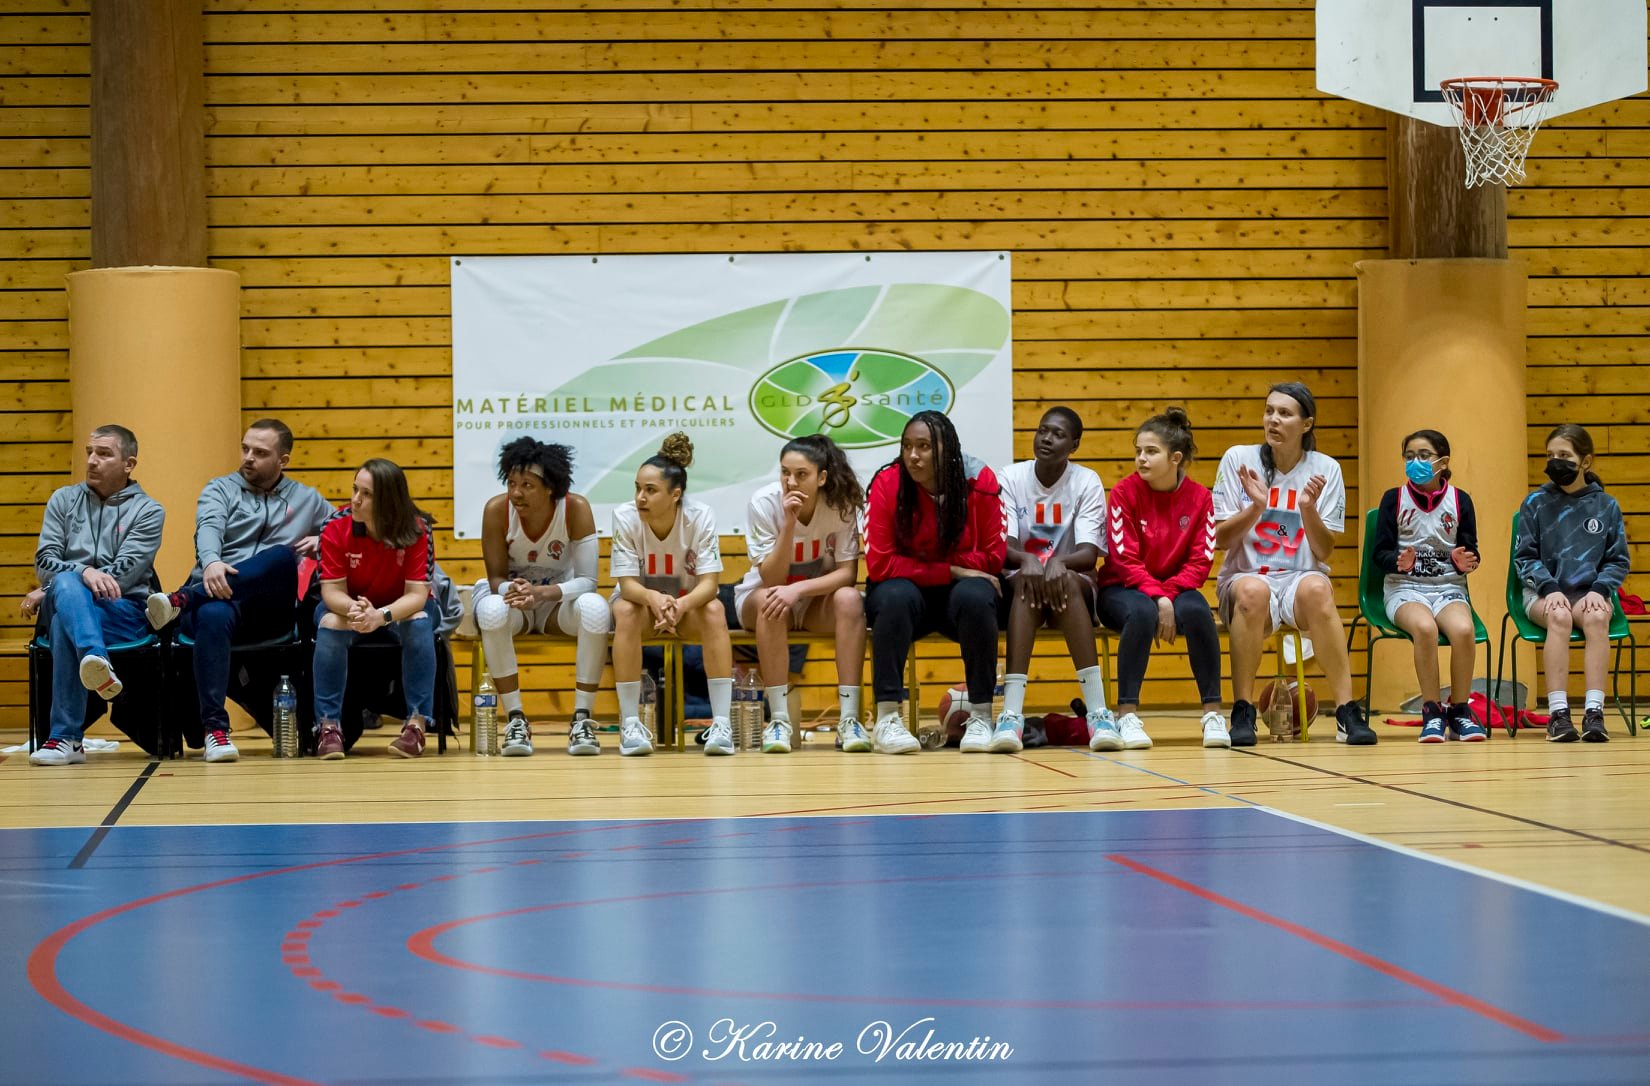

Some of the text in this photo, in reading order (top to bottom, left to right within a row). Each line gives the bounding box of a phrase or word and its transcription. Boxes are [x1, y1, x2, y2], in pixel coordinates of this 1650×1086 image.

[456, 391, 734, 414] MATÉRIEL MÉDICAL
[760, 388, 943, 408] GLD santé
[456, 417, 736, 430] POUR PROFESSIONNELS ET PARTICULIERS
